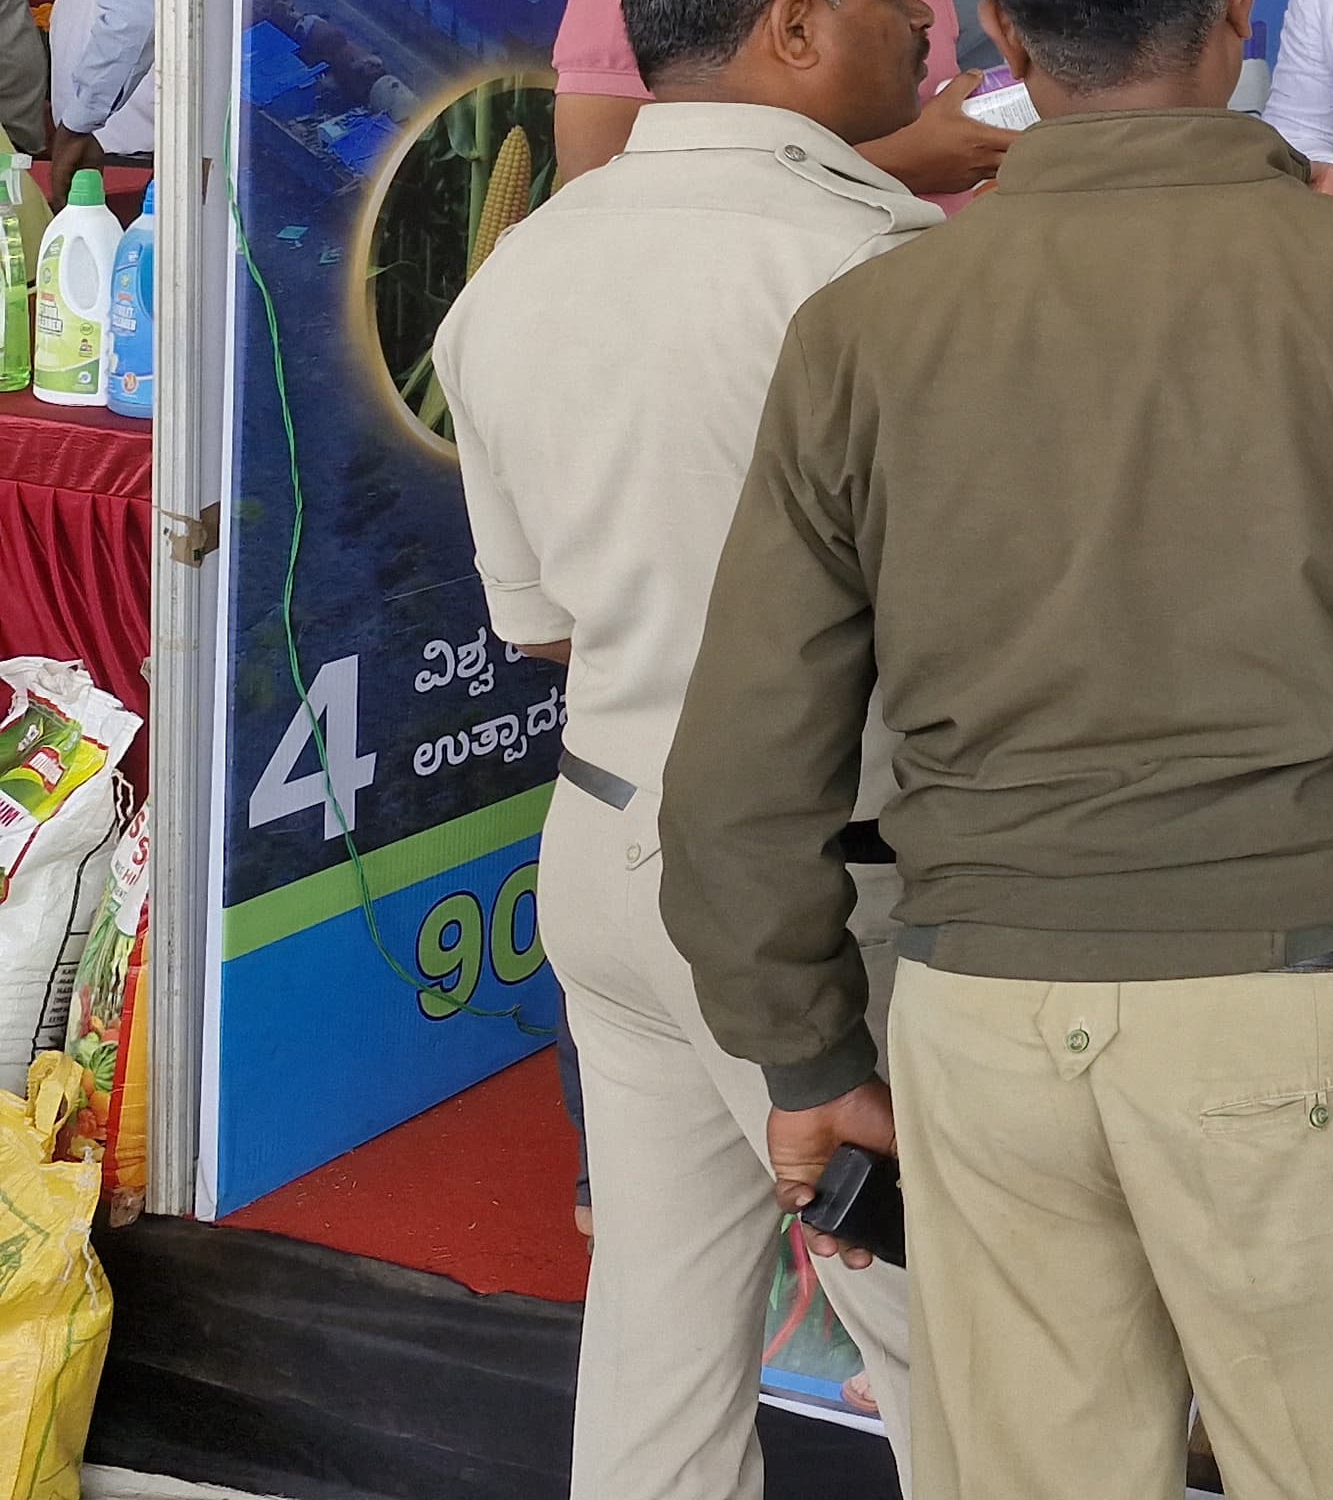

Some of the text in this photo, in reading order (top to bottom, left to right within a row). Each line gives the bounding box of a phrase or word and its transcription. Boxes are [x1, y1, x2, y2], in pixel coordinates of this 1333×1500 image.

[414, 626, 495, 697] ವಿಶ್ವ
[249, 653, 377, 841] 4
[413, 685, 567, 777] ಉತ್ಪಾದ
